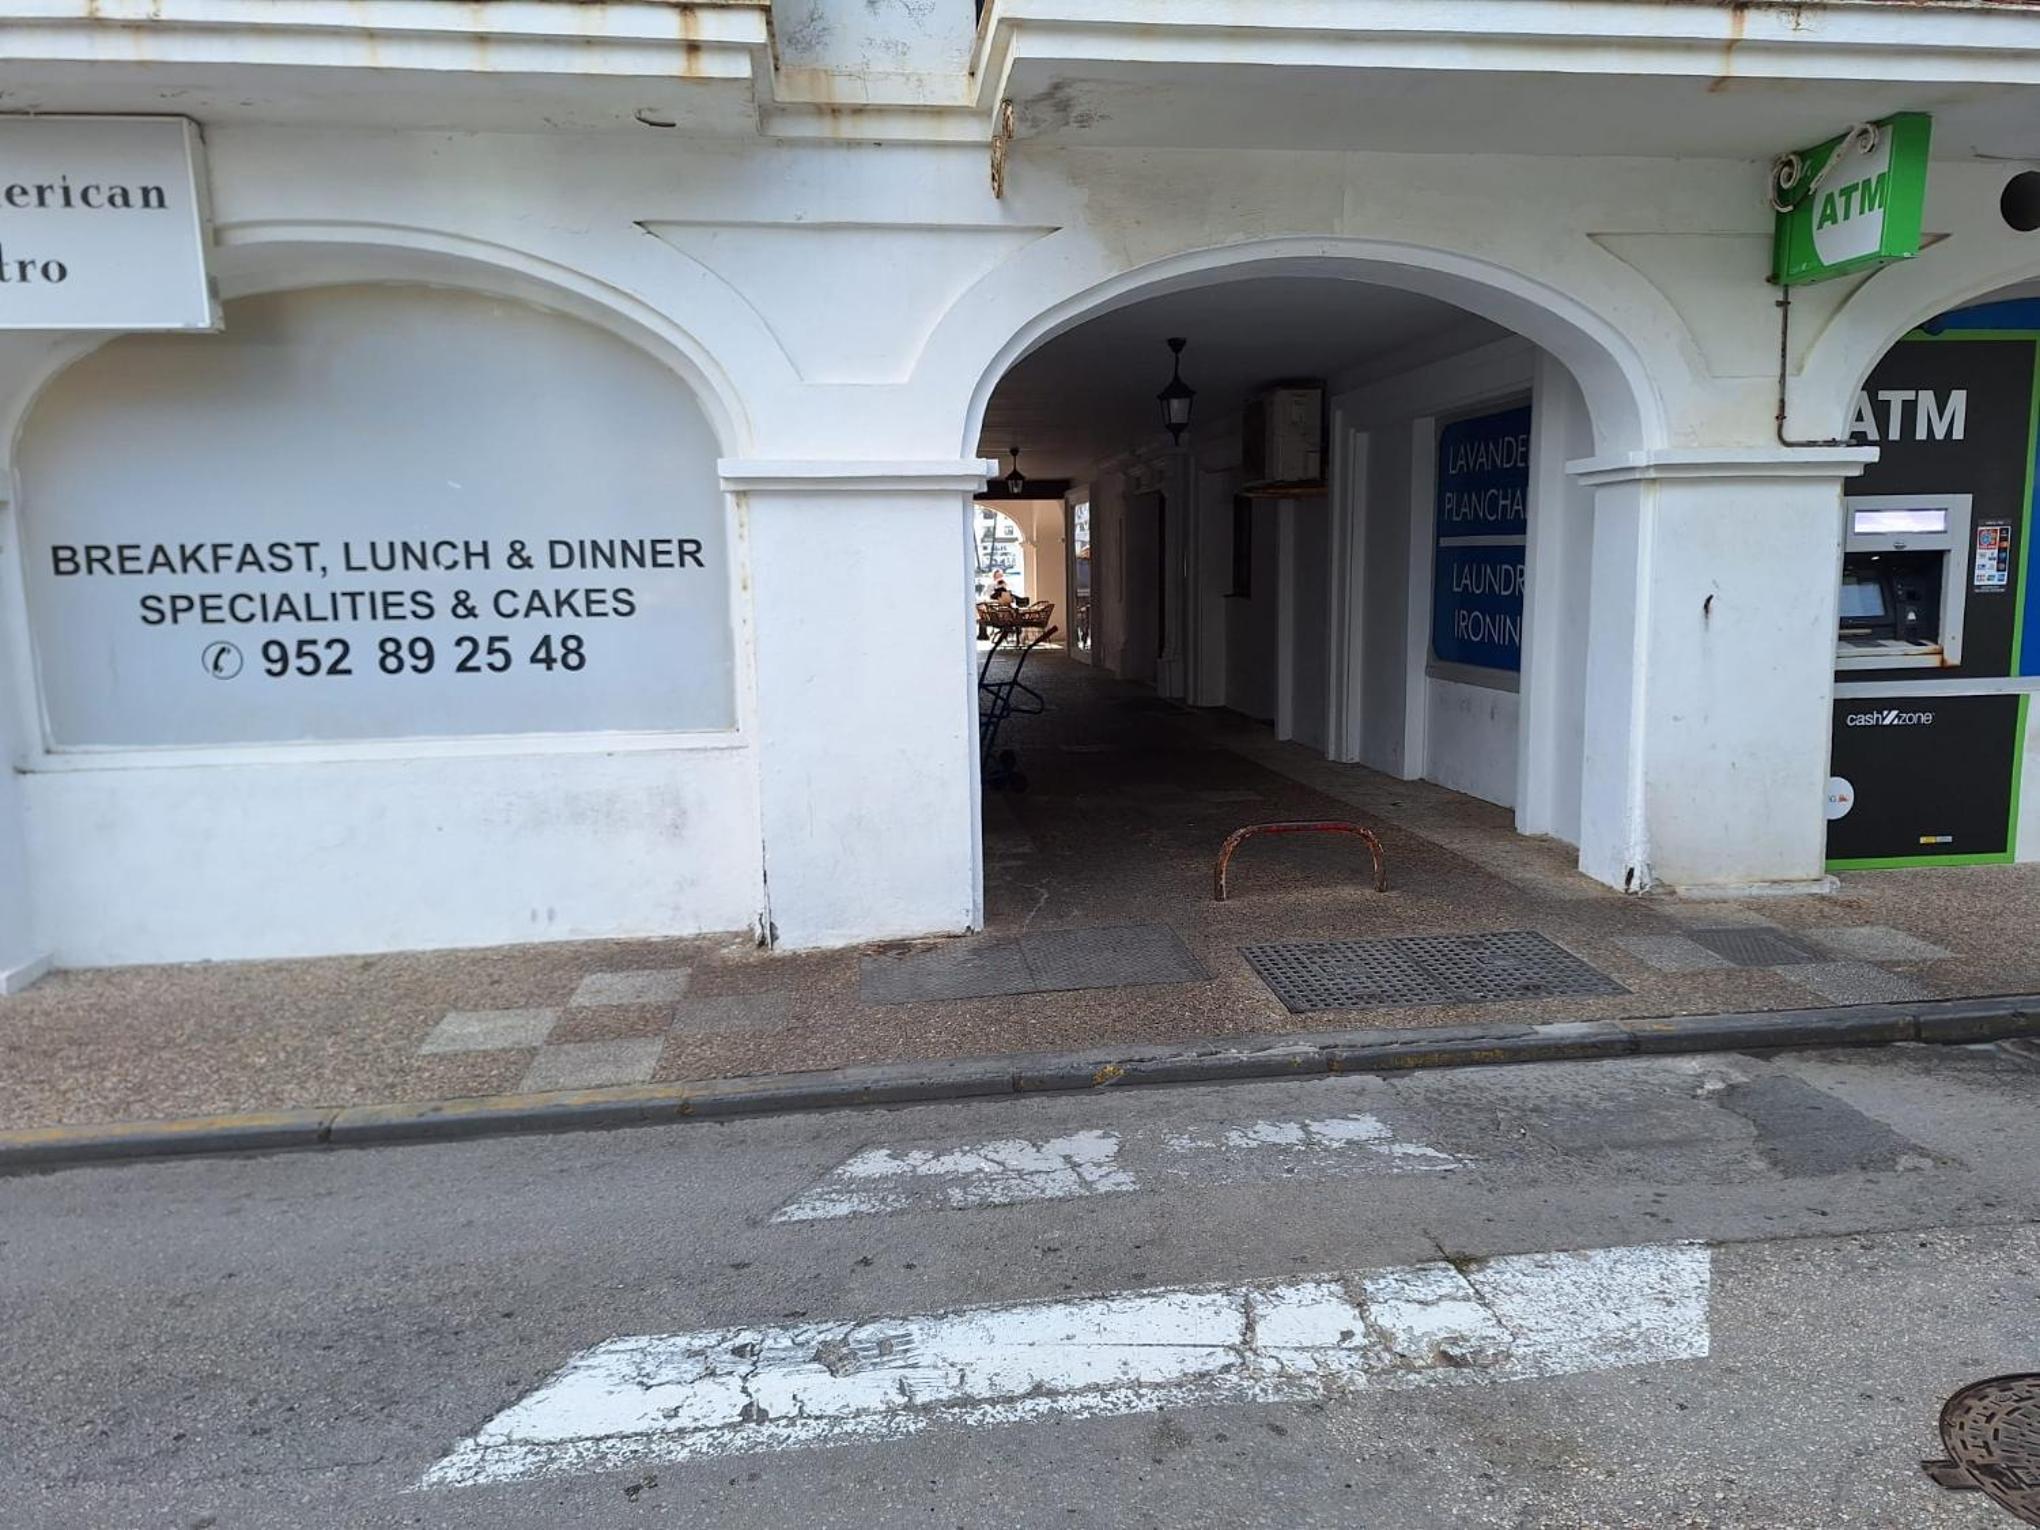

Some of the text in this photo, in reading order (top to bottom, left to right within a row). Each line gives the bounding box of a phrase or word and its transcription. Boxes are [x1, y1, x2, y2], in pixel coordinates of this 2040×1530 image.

[0, 174, 168, 209] erican
[1816, 171, 1888, 231] ATM
[1849, 389, 1968, 441] ATM
[1449, 434, 1530, 474] LAVANDE
[1444, 488, 1527, 521] PLANCHA
[50, 538, 705, 579] BREAKFAST, LUNCH & DINNER
[139, 587, 637, 626] SPECIALITIES & CAKES
[261, 634, 587, 678] 952 89 25 48
